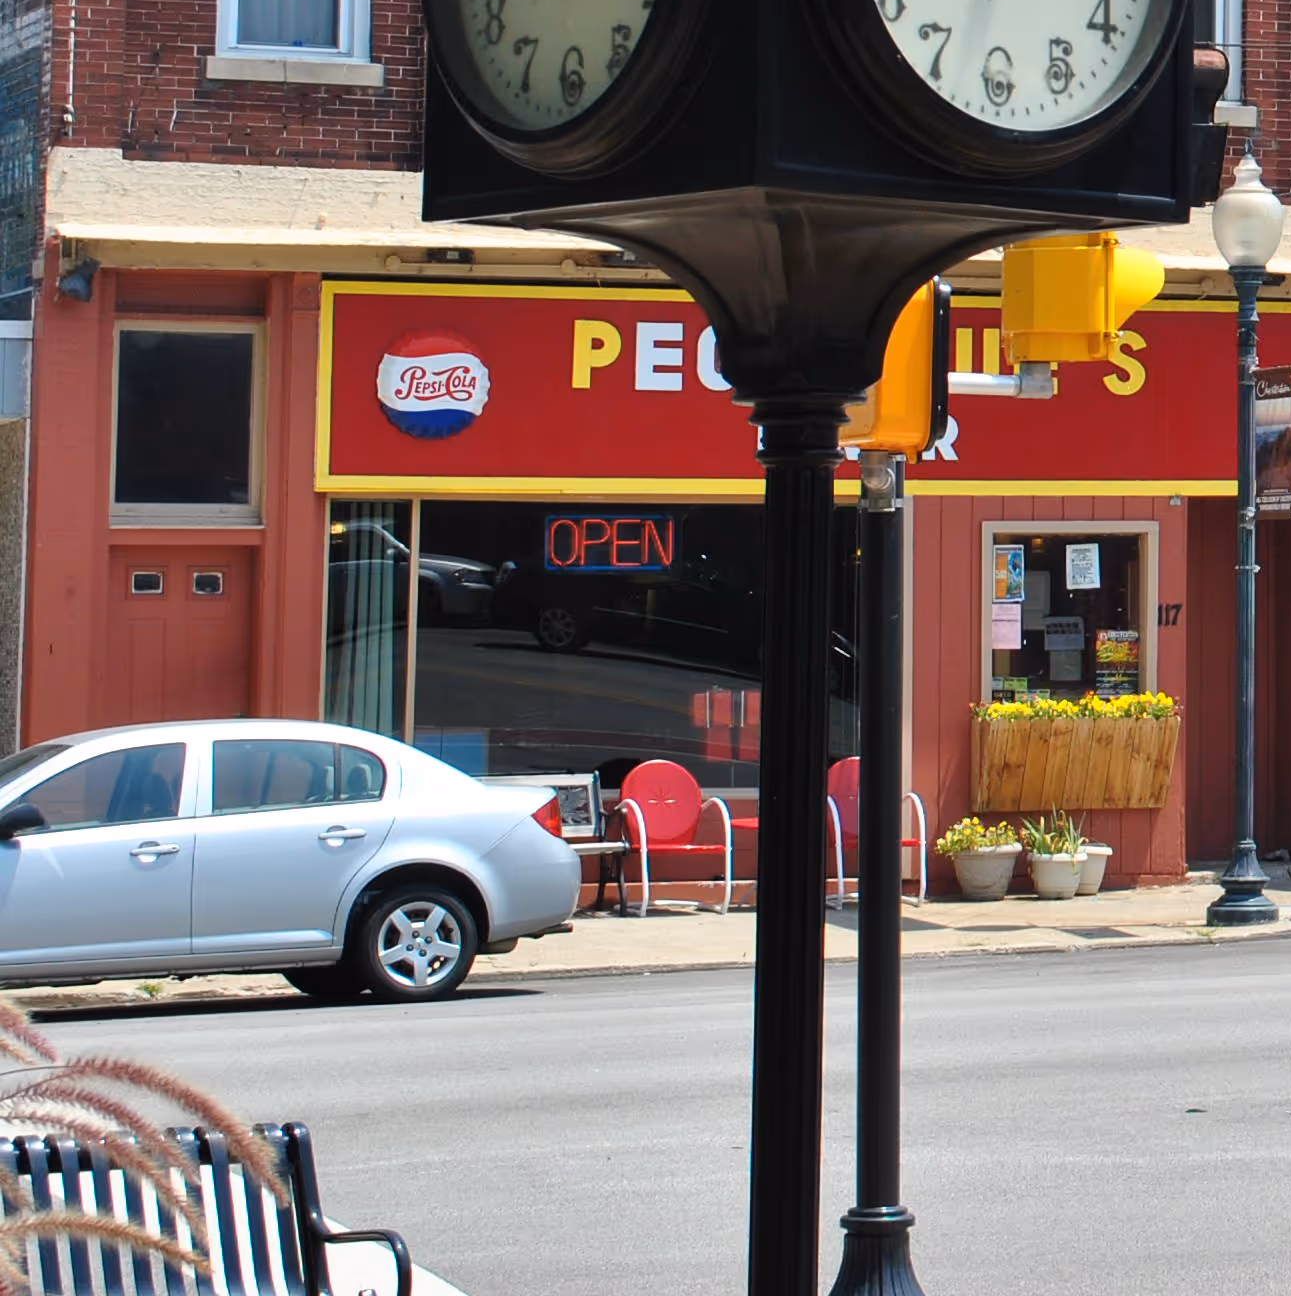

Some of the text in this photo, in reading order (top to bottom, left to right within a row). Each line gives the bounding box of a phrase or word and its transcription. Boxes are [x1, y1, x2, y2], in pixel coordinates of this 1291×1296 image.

[513, 35, 539, 94] 7
[559, 47, 586, 105] 6
[918, 22, 954, 82] 7
[982, 45, 1017, 106] 6
[1046, 37, 1075, 96] 5
[546, 518, 675, 568] OPEN
[1157, 603, 1183, 626] 117
